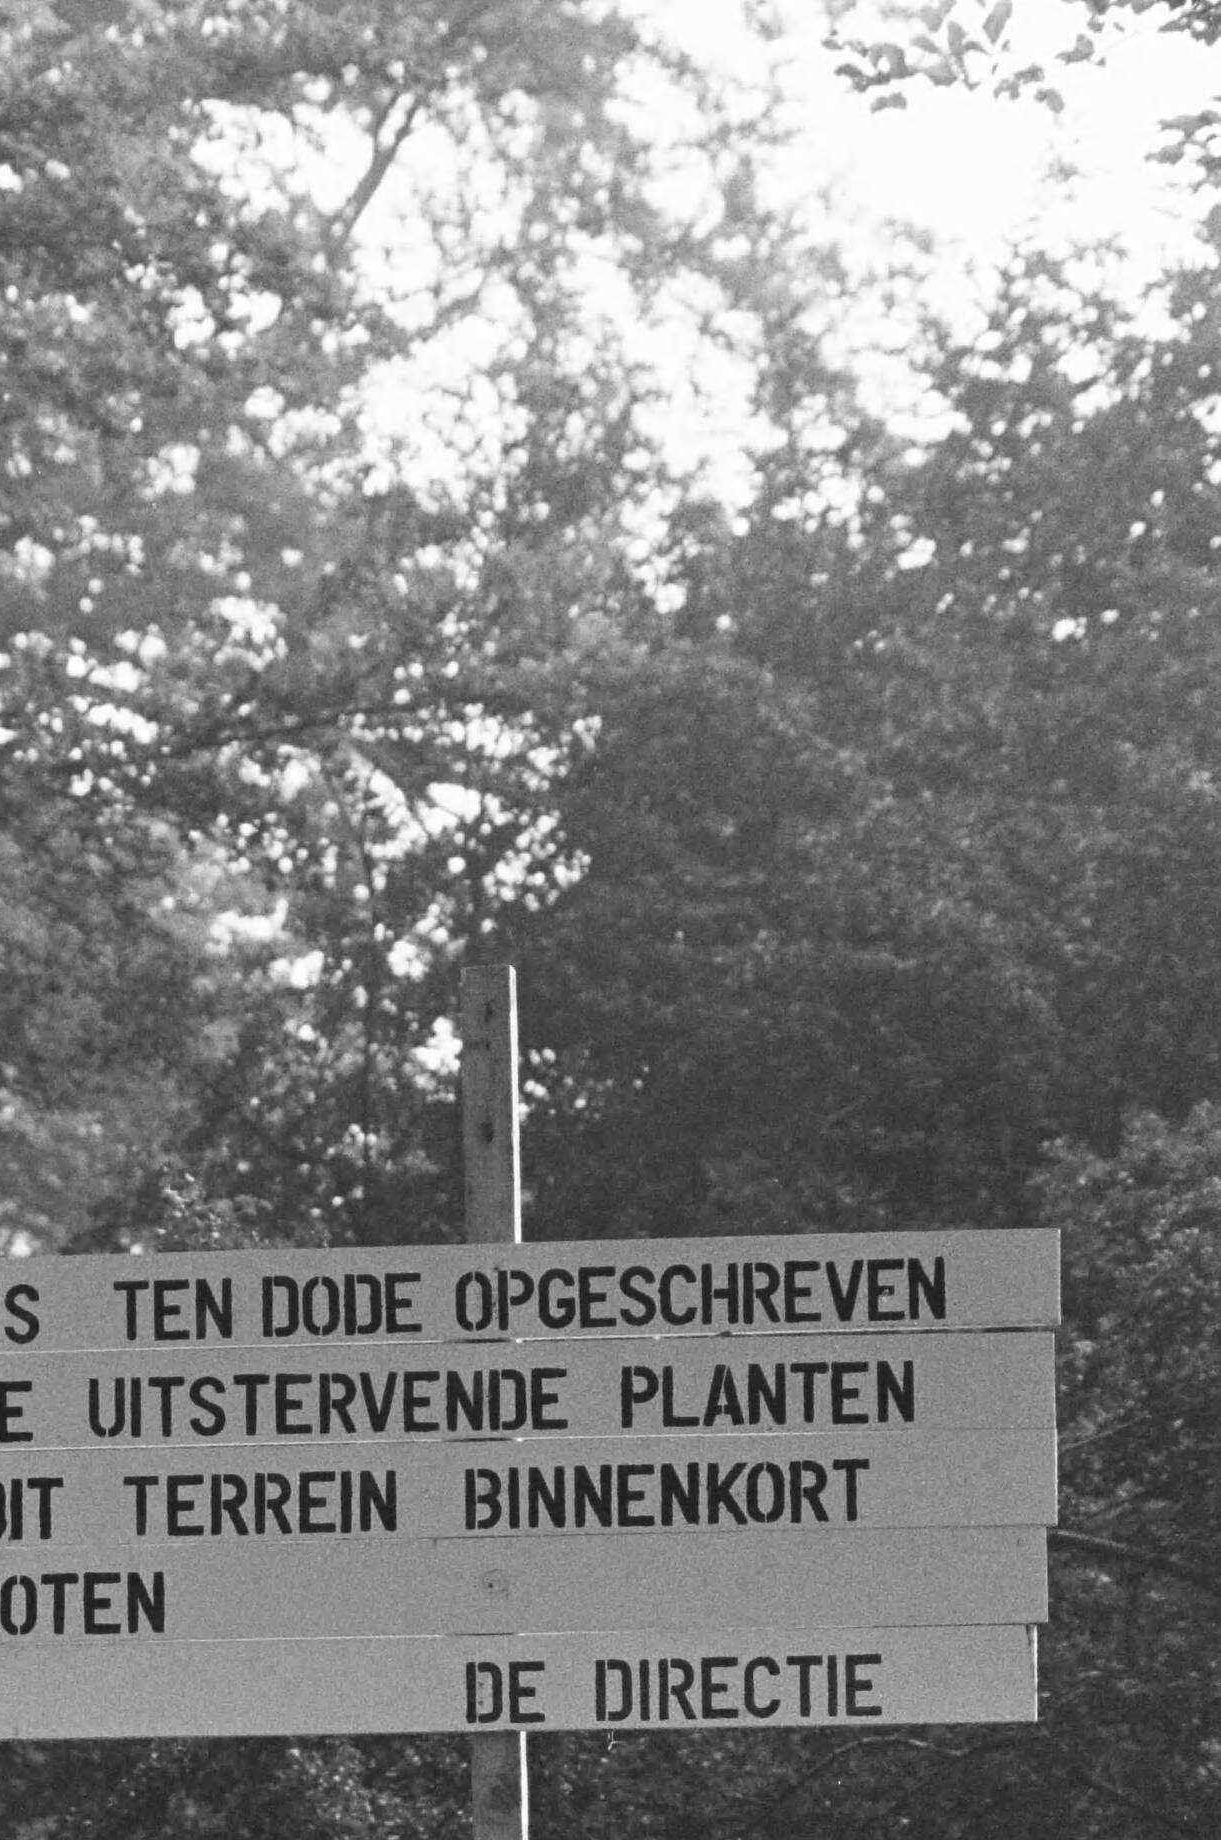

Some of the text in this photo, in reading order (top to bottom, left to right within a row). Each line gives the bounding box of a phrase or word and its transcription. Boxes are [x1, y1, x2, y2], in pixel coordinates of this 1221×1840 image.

[114, 1278, 232, 1340] TEN
[262, 1273, 422, 1337] DODE
[456, 1257, 946, 1331] OPGESCHREVEN
[88, 1368, 568, 1438] UITSTERVENDE
[621, 1361, 914, 1428] PLANTEN
[124, 1471, 396, 1536] TERREIN
[465, 1459, 869, 1529] BINNENKORT
[466, 1654, 881, 1723] DE DIRECTIE
